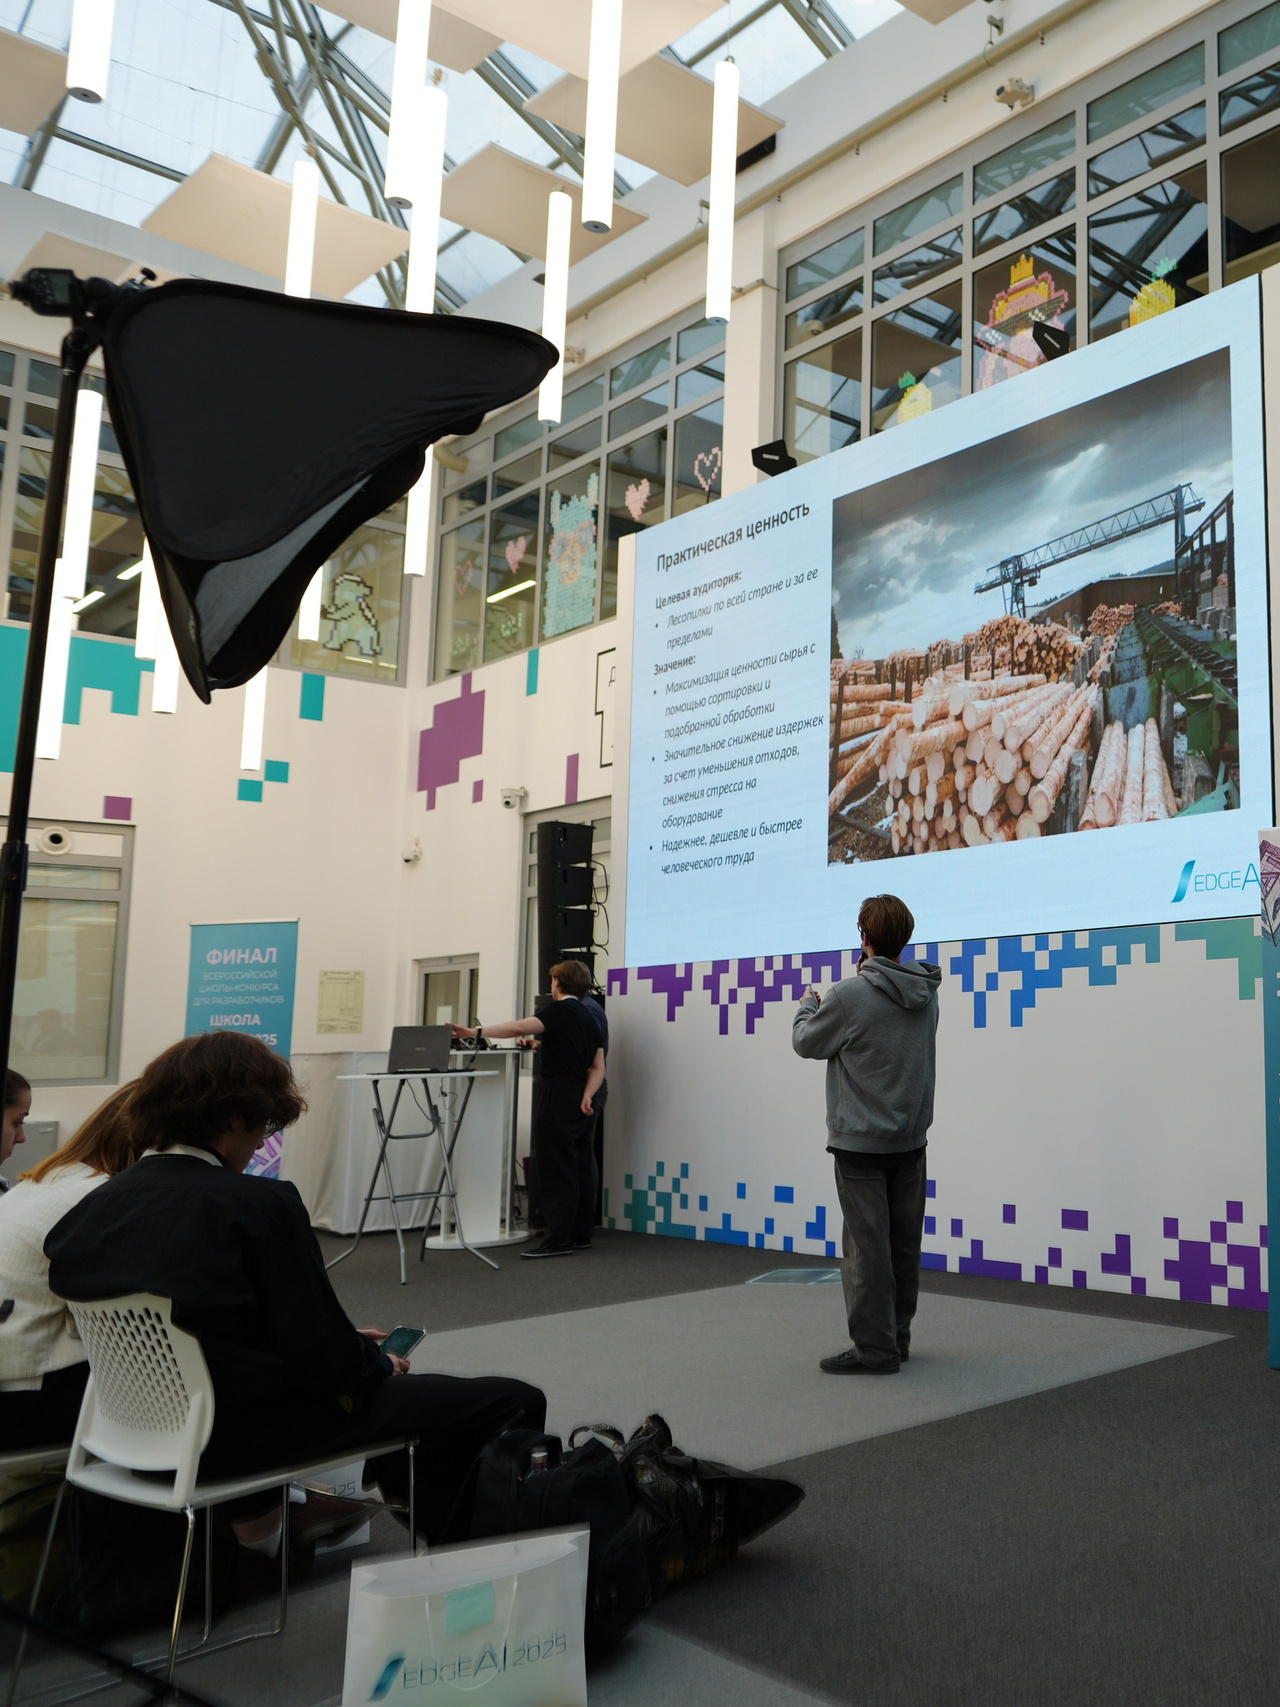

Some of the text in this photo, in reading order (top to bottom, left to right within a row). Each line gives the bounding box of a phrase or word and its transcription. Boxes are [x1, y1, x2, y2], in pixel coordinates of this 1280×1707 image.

[657, 503, 810, 572] Практическая ценность
[655, 571, 742, 610] Целевая аудитория:
[667, 568, 818, 628] Лесопилки по всей стране и за ее
[667, 626, 713, 650] пределами
[654, 655, 696, 676] Значение:
[665, 642, 816, 695] Максимизация ценности сырья с
[665, 679, 771, 717] помощью сортировки и
[664, 702, 775, 739] подобранной обработки
[664, 715, 824, 762] Значительное снижение издержек
[663, 745, 800, 784] за счет уменьшения отходов,
[662, 777, 757, 807] снижения стресса на
[662, 808, 723, 829] оборудование
[662, 818, 803, 852] Надежнее, дешевле и быстрее
[661, 851, 754, 875] человеческого труда
[1194, 863, 1261, 892] EDGEA
[206, 948, 278, 965] ФИНАЛ
[199, 983, 279, 994] ШКОЛЫ-КОНКУРСА
[212, 995, 284, 1006] РАЗРАБОТЧИКОВ
[210, 1014, 261, 1027] ШКОЛА
